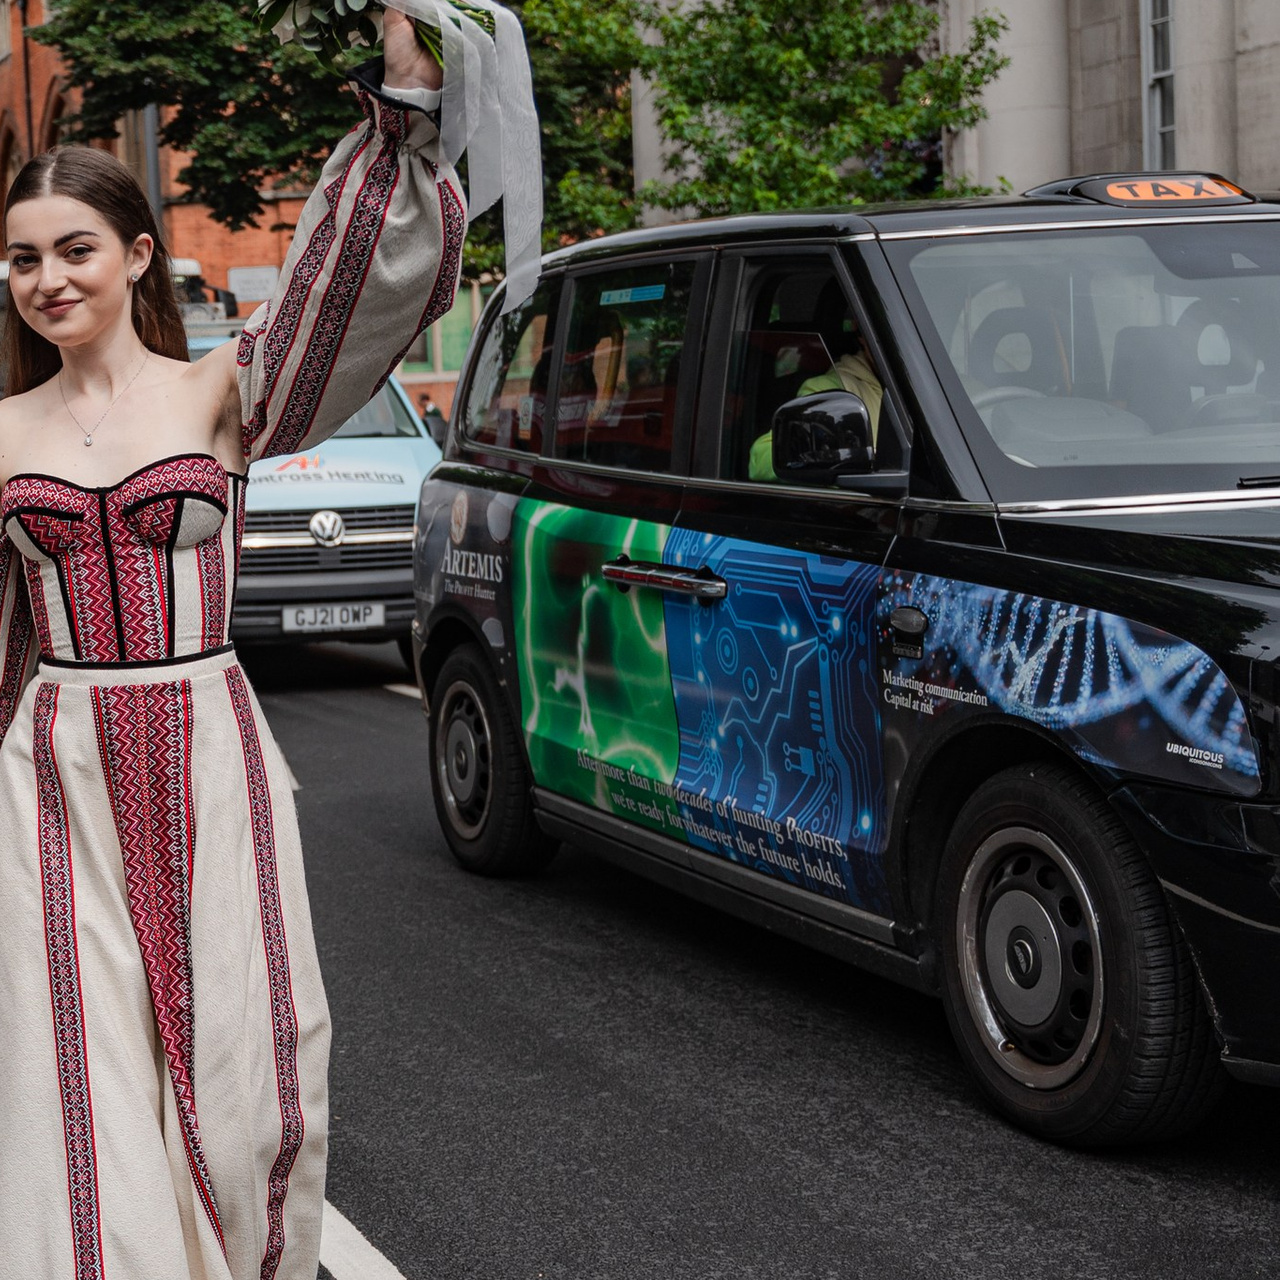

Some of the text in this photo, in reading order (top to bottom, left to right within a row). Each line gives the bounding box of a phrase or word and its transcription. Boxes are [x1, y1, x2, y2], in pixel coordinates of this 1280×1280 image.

[1117, 180, 1233, 198] TAXI
[440, 536, 503, 583] ARTEMIS
[474, 583, 496, 600] Hunter
[340, 606, 373, 624] OWP
[882, 669, 988, 707] Marketing communication
[884, 688, 935, 715] Capital at risk
[1166, 742, 1224, 763] UBIQUITOUS
[577, 748, 601, 772] After
[601, 761, 626, 783] more
[627, 764, 651, 792] than
[654, 778, 673, 799] two
[673, 780, 713, 813] decades
[716, 795, 730, 819] of
[731, 798, 784, 845] hunting
[637, 800, 665, 828] ready
[666, 804, 683, 830] for
[682, 813, 733, 848] whatever
[735, 830, 758, 857] the
[758, 837, 801, 873] future
[801, 852, 847, 891] holds.
